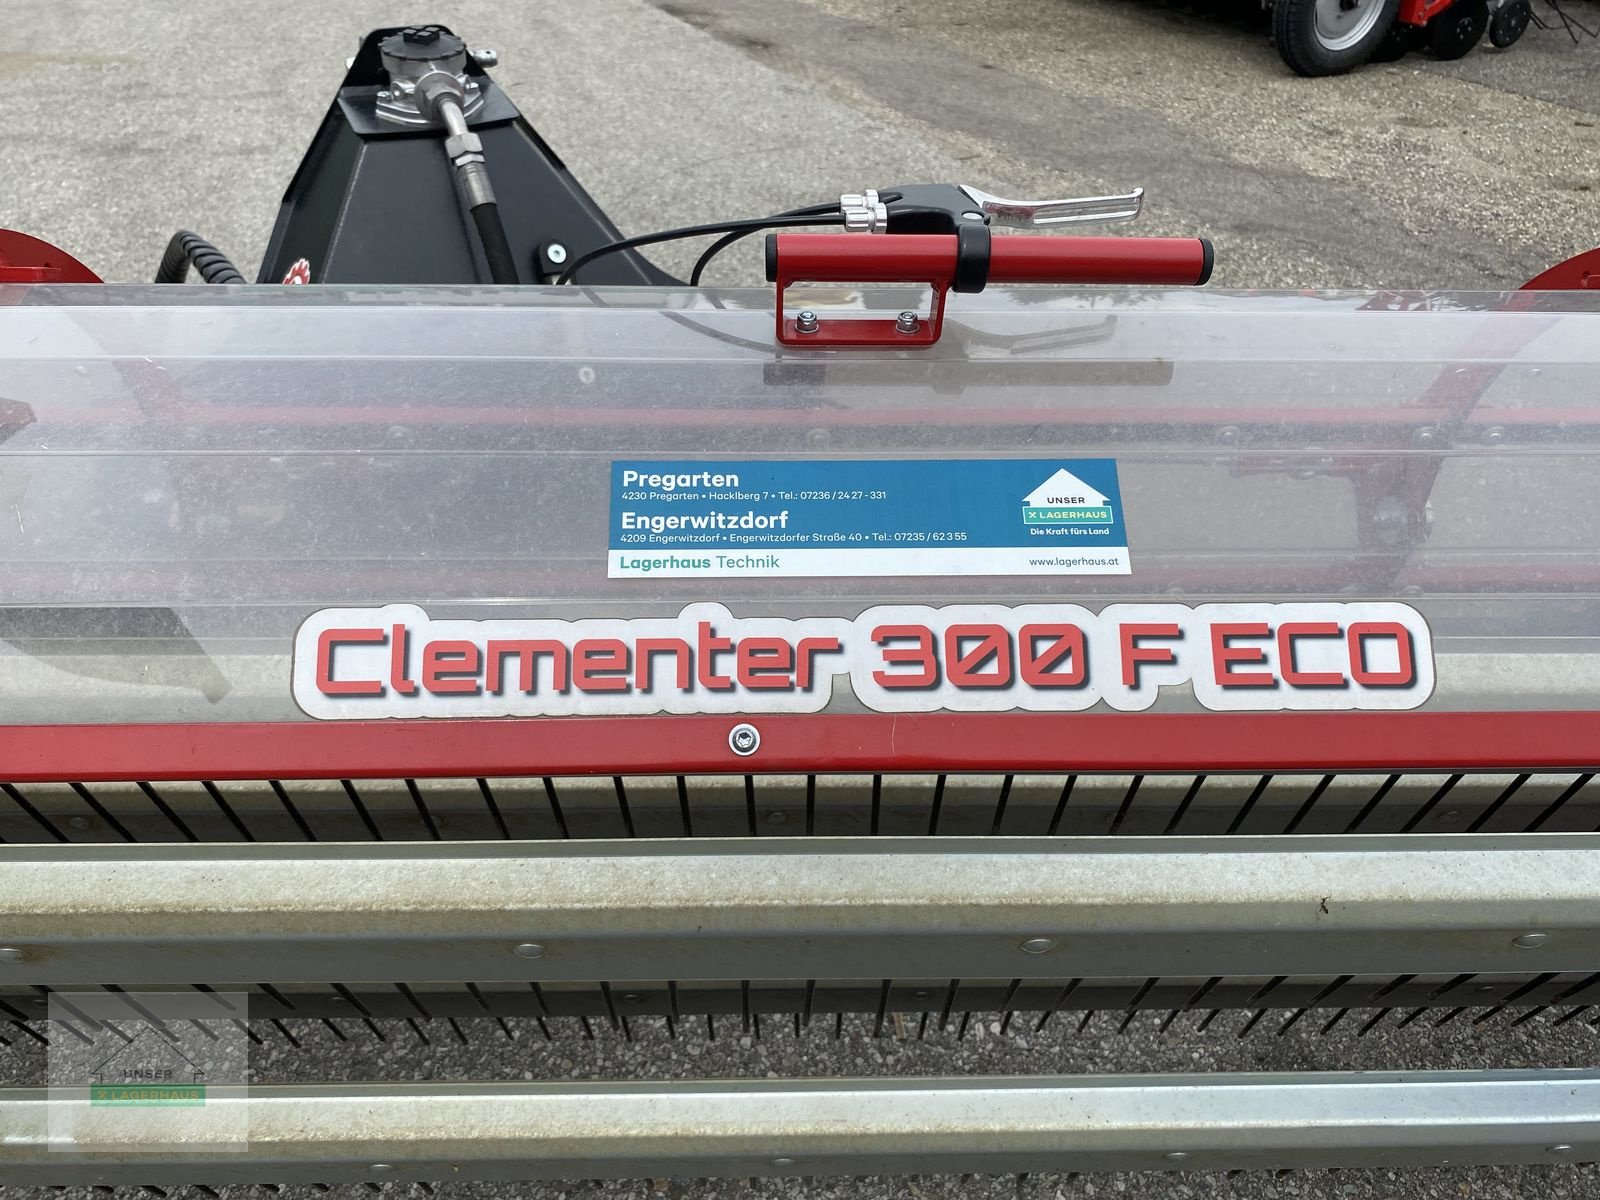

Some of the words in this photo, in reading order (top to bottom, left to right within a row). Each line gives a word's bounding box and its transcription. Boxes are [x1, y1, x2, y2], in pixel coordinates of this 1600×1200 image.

[623, 471, 739, 490] Pregarten
[622, 492, 647, 500] 4230
[650, 492, 699, 501] Pregarten
[709, 491, 760, 501] Hacklberg
[1040, 511, 1107, 519] LAGERHAUS
[622, 511, 788, 533] Engerwitzdorf
[1070, 527, 1087, 535] fürs
[620, 534, 646, 543] 4209
[649, 533, 720, 544] Engerwitzdorf
[730, 533, 810, 543] Engerwitzdorfer
[812, 533, 846, 541] Straße
[849, 533, 862, 541] 40
[620, 556, 711, 571] Lagerhaus
[716, 555, 779, 568] Technik
[1029, 557, 1119, 567] www.lagerhaus.at
[315, 621, 843, 699] Clementer
[871, 623, 1088, 690] 300
[1119, 622, 1184, 688] F
[1210, 621, 1416, 689] ECO
